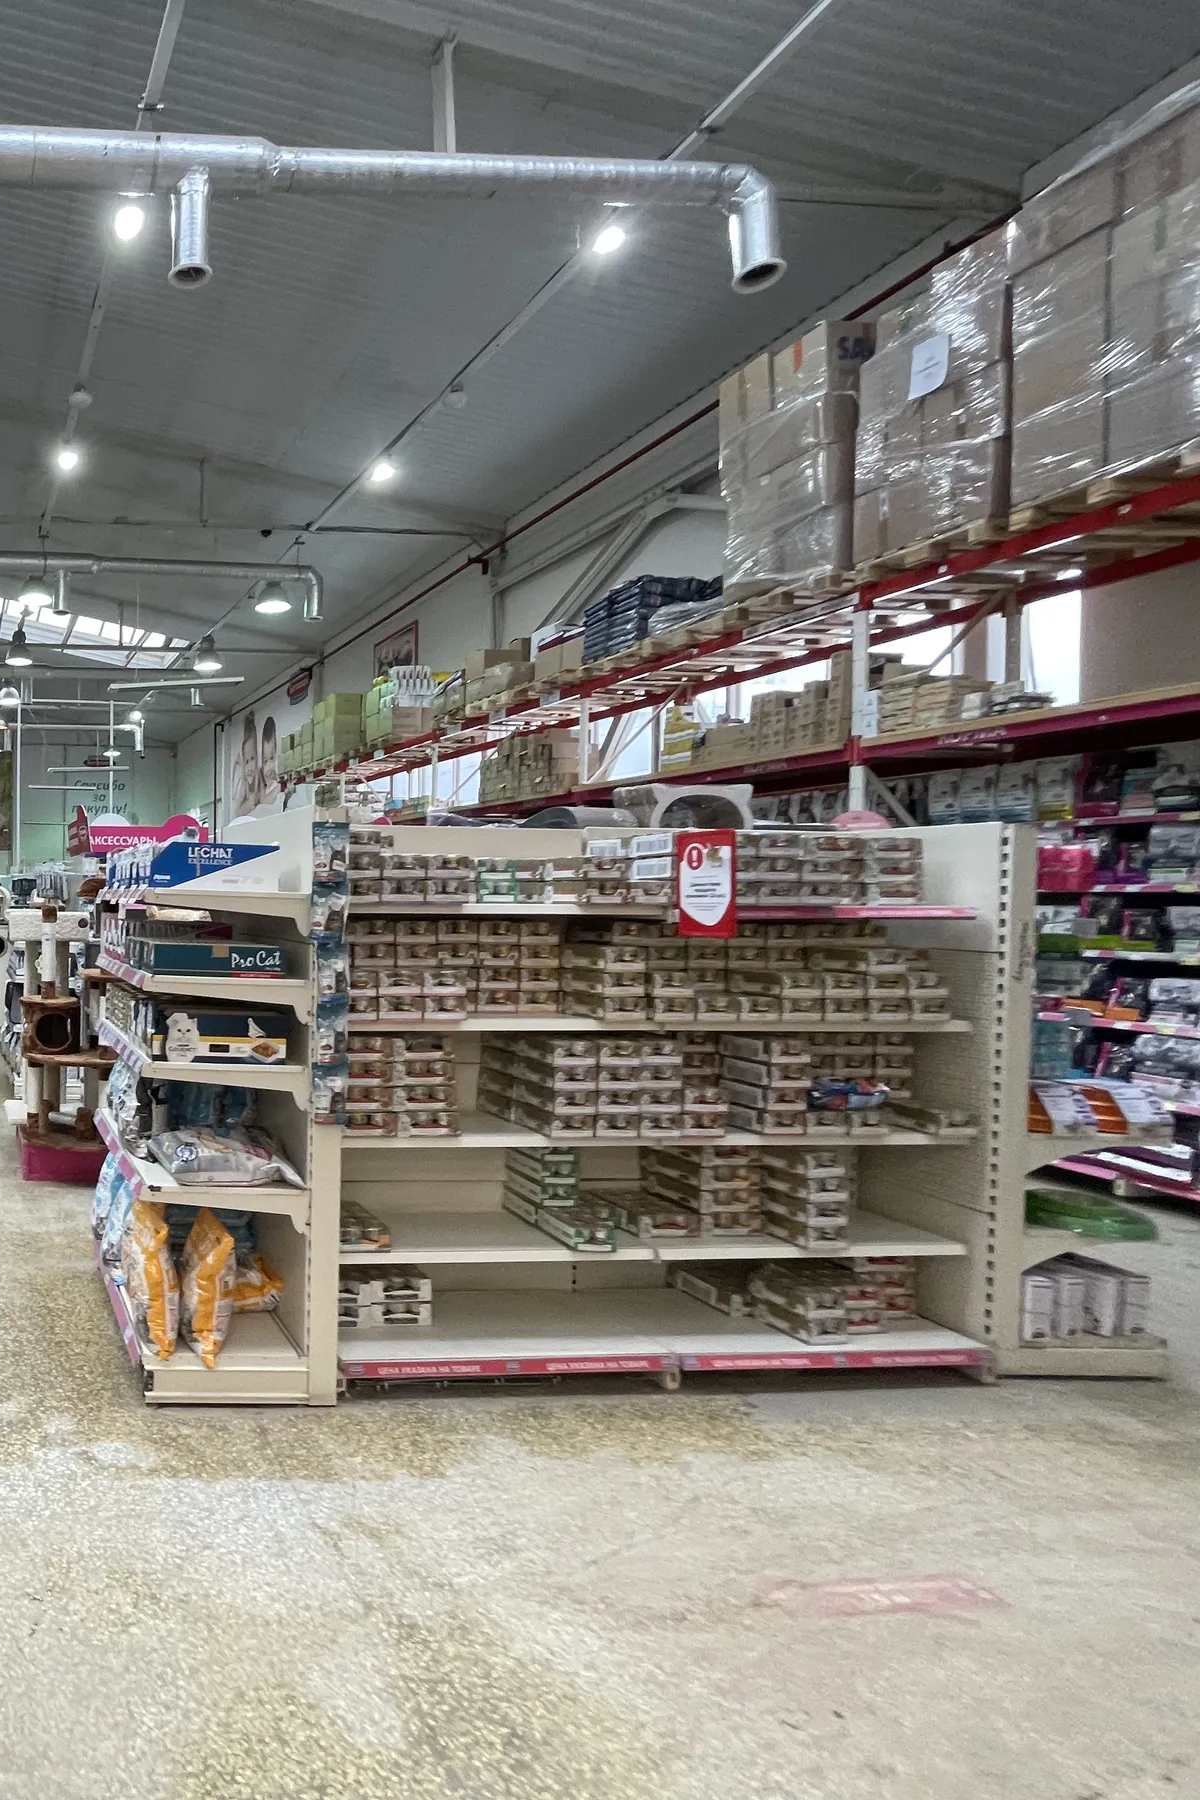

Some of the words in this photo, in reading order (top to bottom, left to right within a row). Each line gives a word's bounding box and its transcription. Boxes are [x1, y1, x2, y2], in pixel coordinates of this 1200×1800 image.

[92, 793, 106, 801] за
[71, 803, 128, 816] пкупу!
[90, 835, 157, 846] АКСЕССУАРЫ
[188, 846, 233, 859] LECHAT
